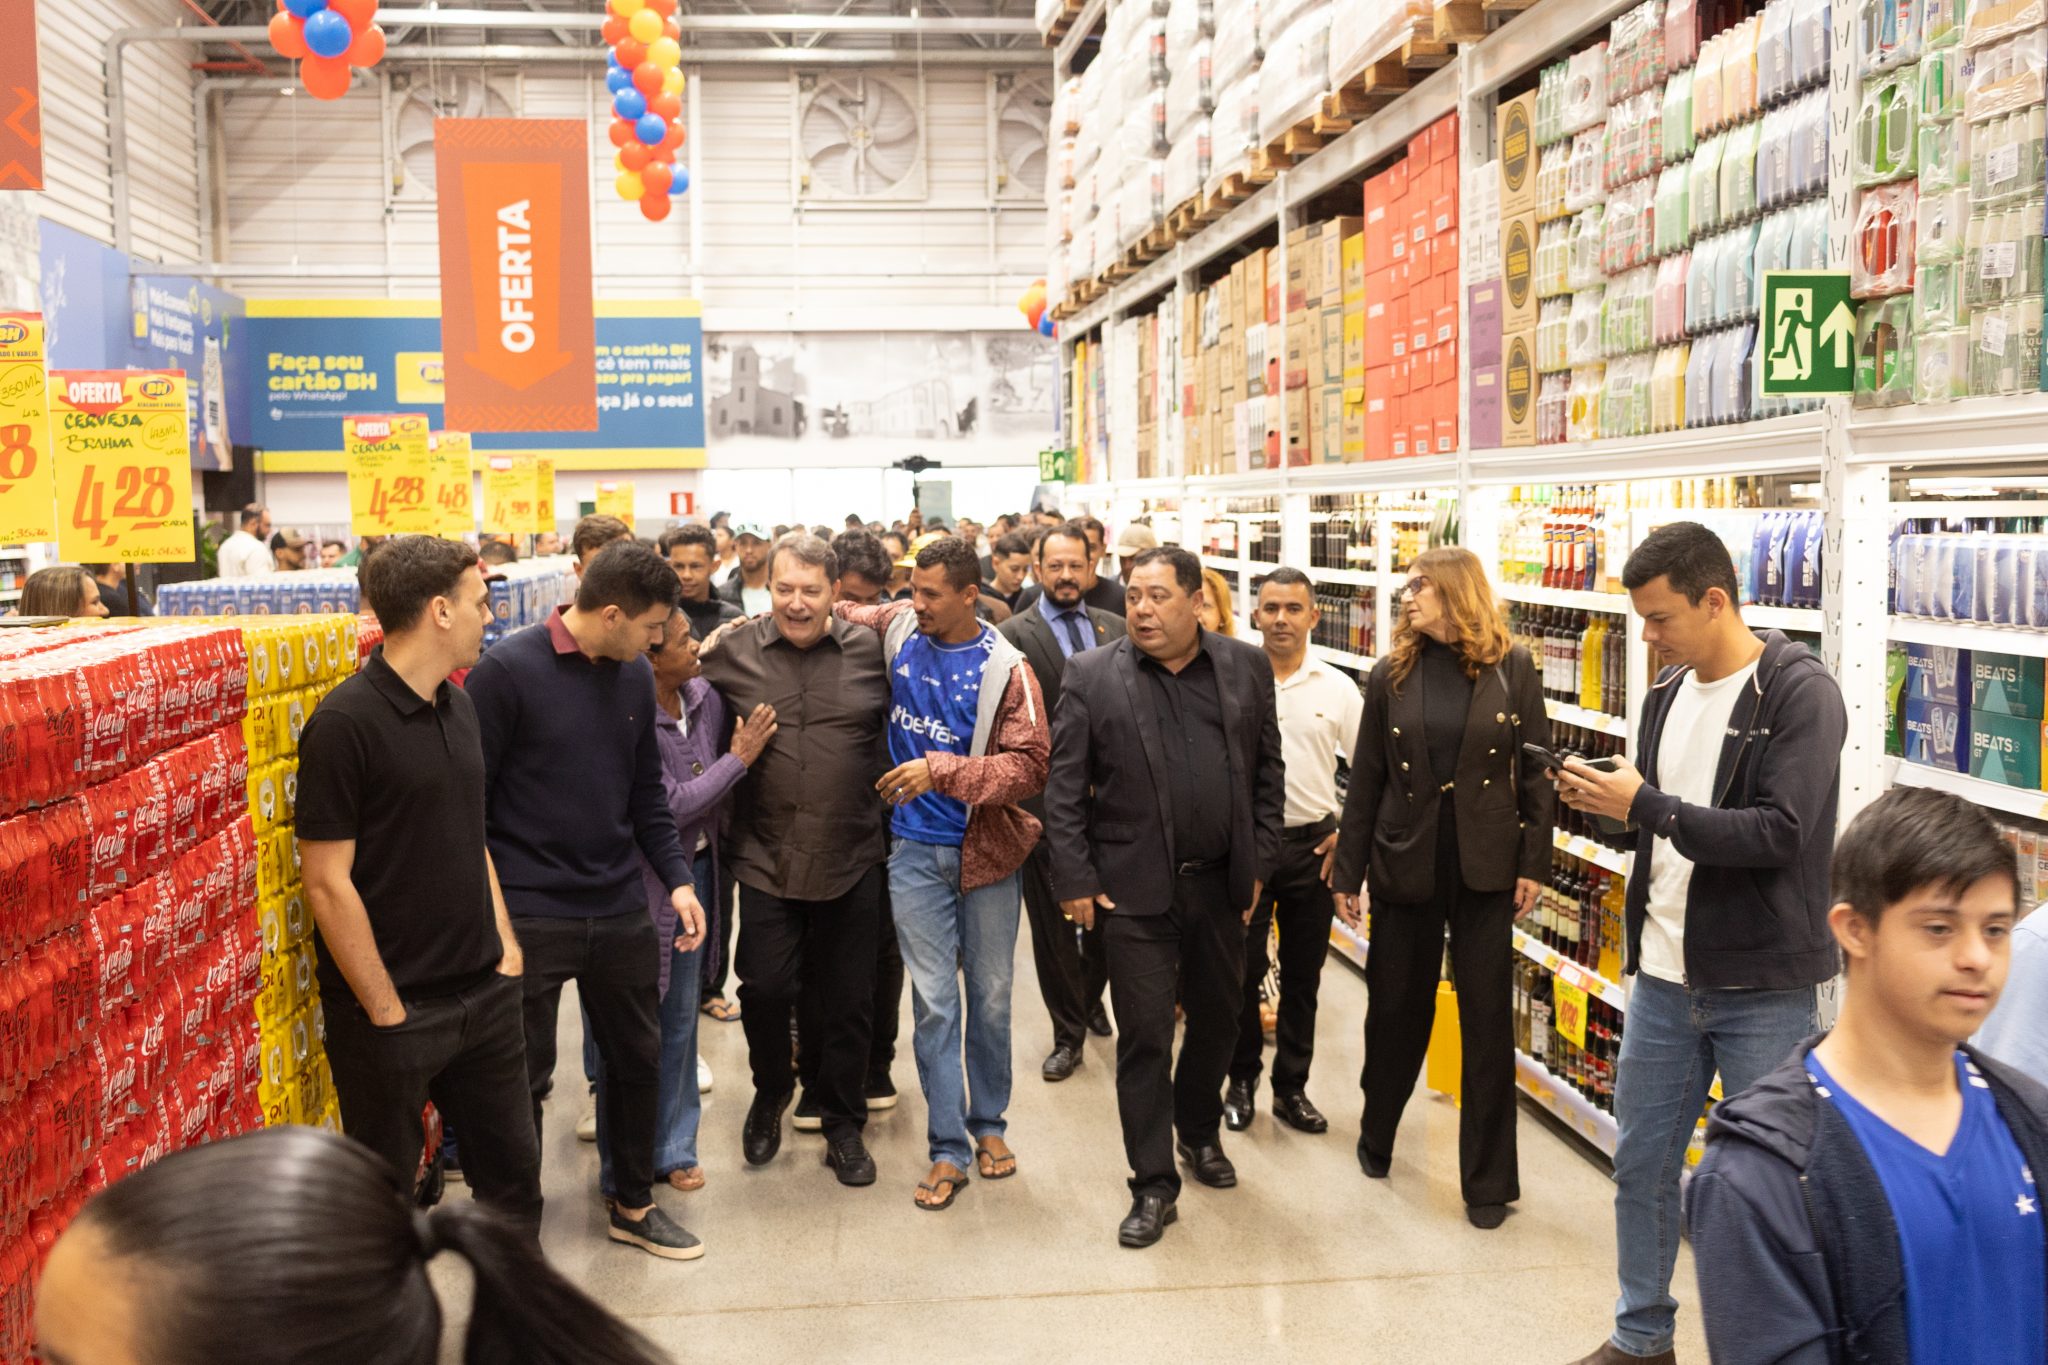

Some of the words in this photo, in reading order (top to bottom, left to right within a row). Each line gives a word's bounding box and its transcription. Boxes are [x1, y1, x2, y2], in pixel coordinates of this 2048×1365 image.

[496, 199, 536, 354] OFERTA
[268, 352, 321, 375] Faça
[324, 355, 364, 371] seu
[596, 356, 615, 371] cê
[618, 357, 650, 371] tem
[653, 356, 691, 371] mais
[268, 371, 341, 391] cartão
[344, 372, 377, 391] BH
[69, 382, 123, 404] OFERTA
[622, 392, 640, 411] já
[642, 395, 655, 408] o
[658, 393, 693, 408] seu!
[64, 413, 144, 430] CERVEJA
[60, 434, 134, 453] BRAHMA
[352, 442, 402, 455] CERVEJA
[73, 464, 175, 548] 4,28
[369, 476, 425, 527] 4,28
[1908, 656, 1934, 669] BEATS
[1976, 664, 2016, 682] BEATS
[1976, 680, 1985, 690] GT
[900, 708, 961, 745] betfar
[1907, 720, 1932, 734] BEATS
[1974, 732, 2013, 753] BEATS
[1974, 749, 1982, 758] GT
